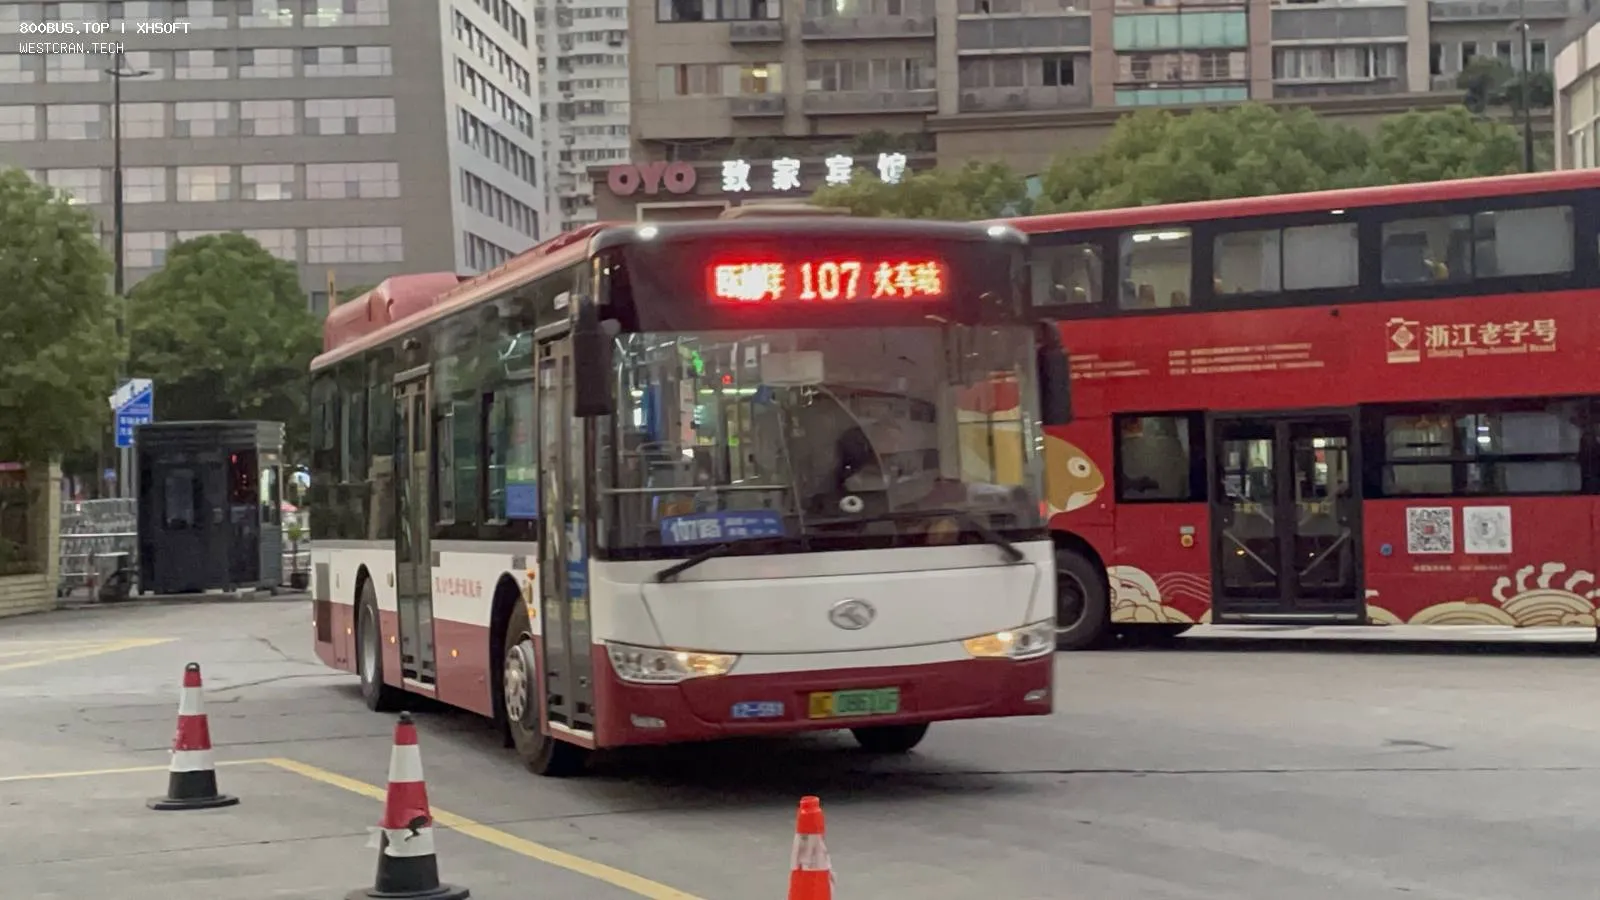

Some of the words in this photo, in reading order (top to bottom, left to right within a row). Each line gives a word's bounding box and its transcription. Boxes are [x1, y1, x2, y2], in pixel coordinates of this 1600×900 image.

[607, 161, 697, 195] OYO
[721, 152, 906, 192] 致家宾馆
[800, 262, 861, 300] 107
[872, 261, 941, 299] 火车站
[1425, 319, 1557, 348] 浙江老字号
